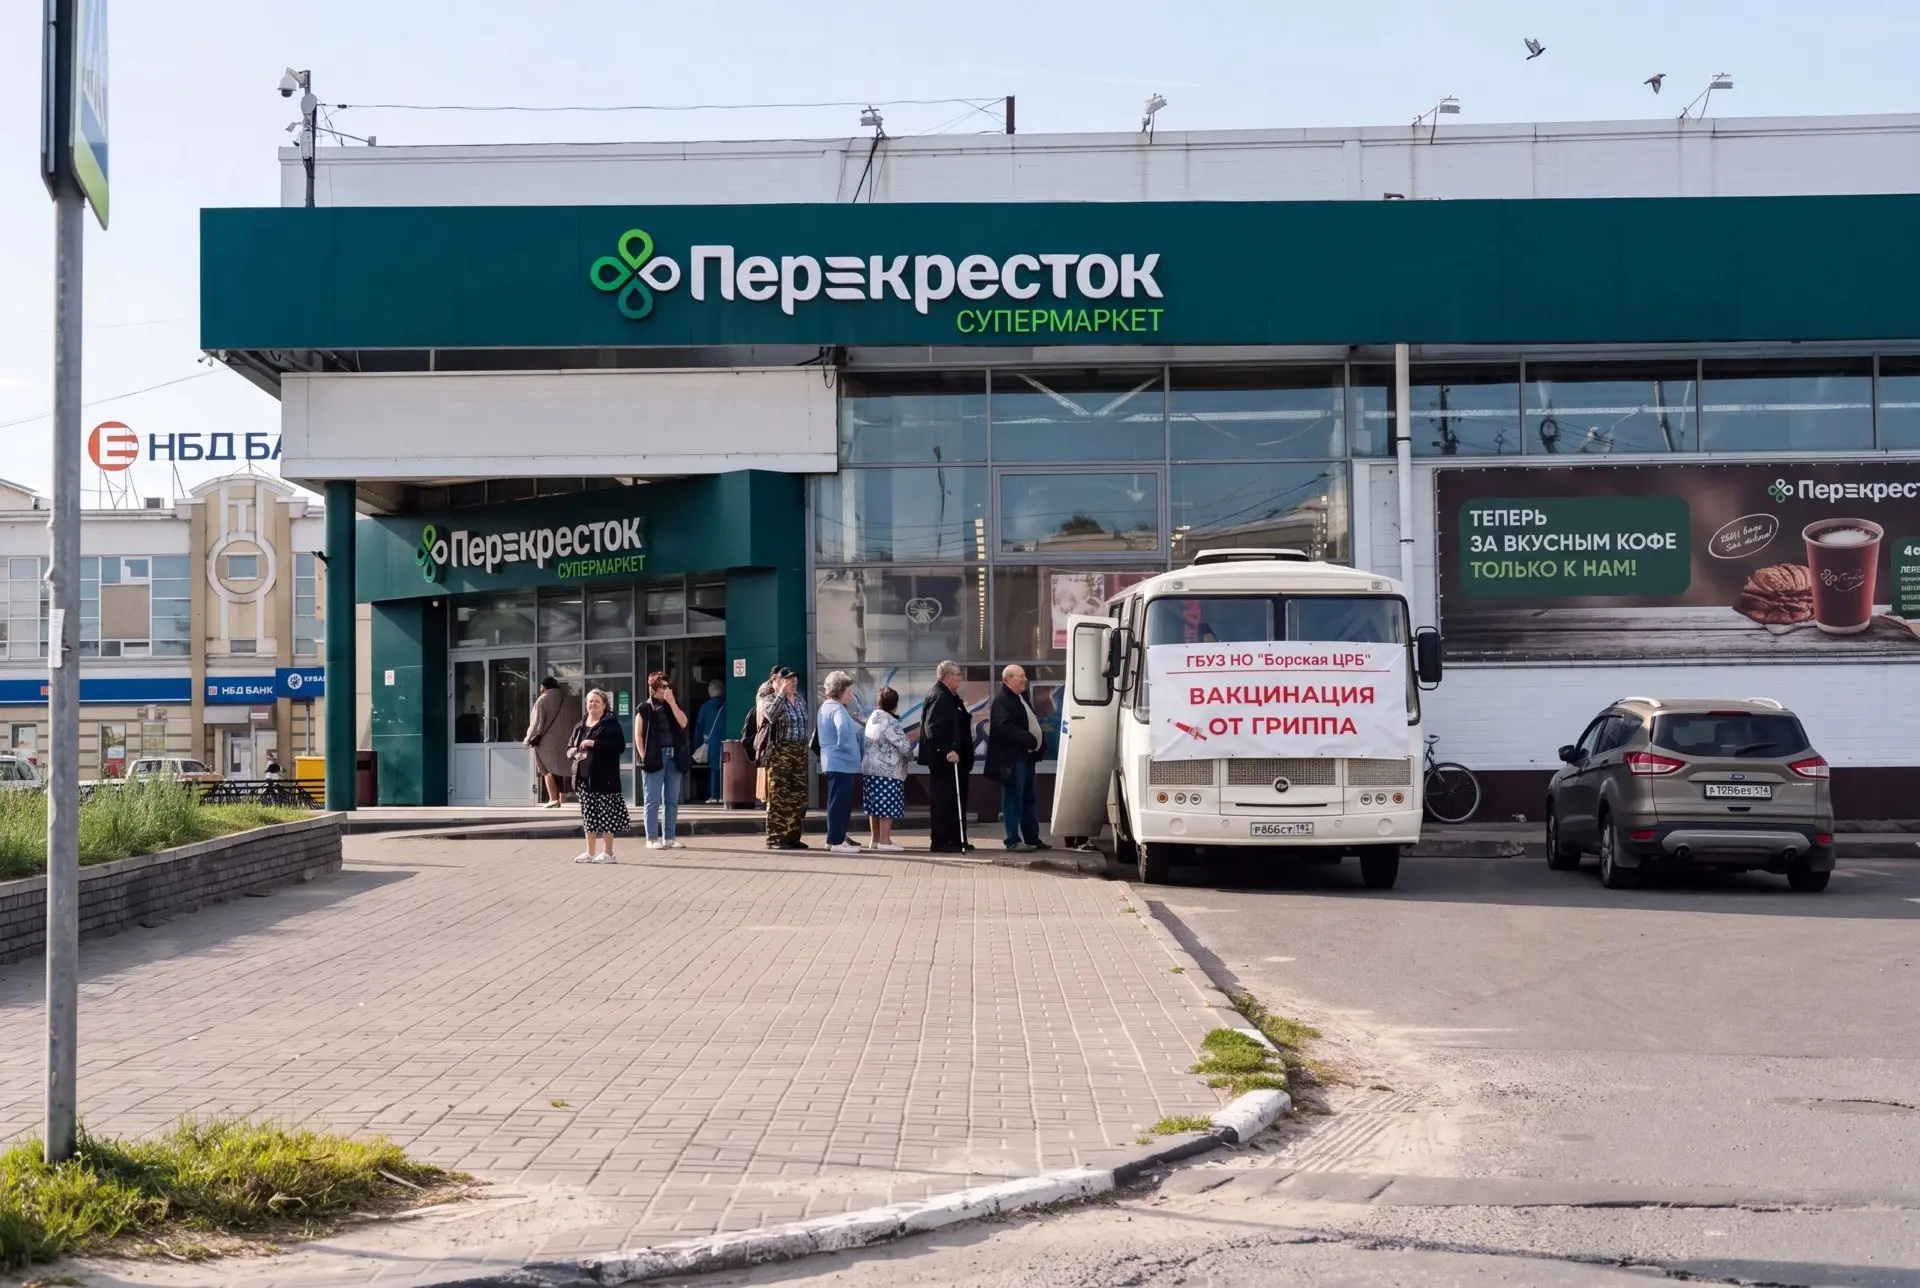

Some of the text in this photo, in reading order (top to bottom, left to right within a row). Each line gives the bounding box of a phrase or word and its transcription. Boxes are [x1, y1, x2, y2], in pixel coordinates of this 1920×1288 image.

[691, 245, 1164, 315] Перекресток
[957, 308, 1164, 333] СУПЕРМАРКЕТ
[149, 432, 236, 461] НБД
[1470, 509, 1548, 527] ТЕПЕРЬ
[451, 517, 642, 574] Перекресток
[1470, 532, 1677, 552] ЗА ВКУСНЫМ КОФЕ
[558, 555, 646, 579] СУПЕРМАРКЕТ
[1470, 559, 1637, 579] ТОЛЬКО К НАМ!
[1186, 653, 1371, 668] ГБУЗ НО "Борская ЦРБ"
[222, 686, 273, 695] НБД БАНК
[1190, 686, 1374, 707] ВАКЦИНАЦИЯ
[1209, 717, 1357, 735] ОТ ГРИППА
